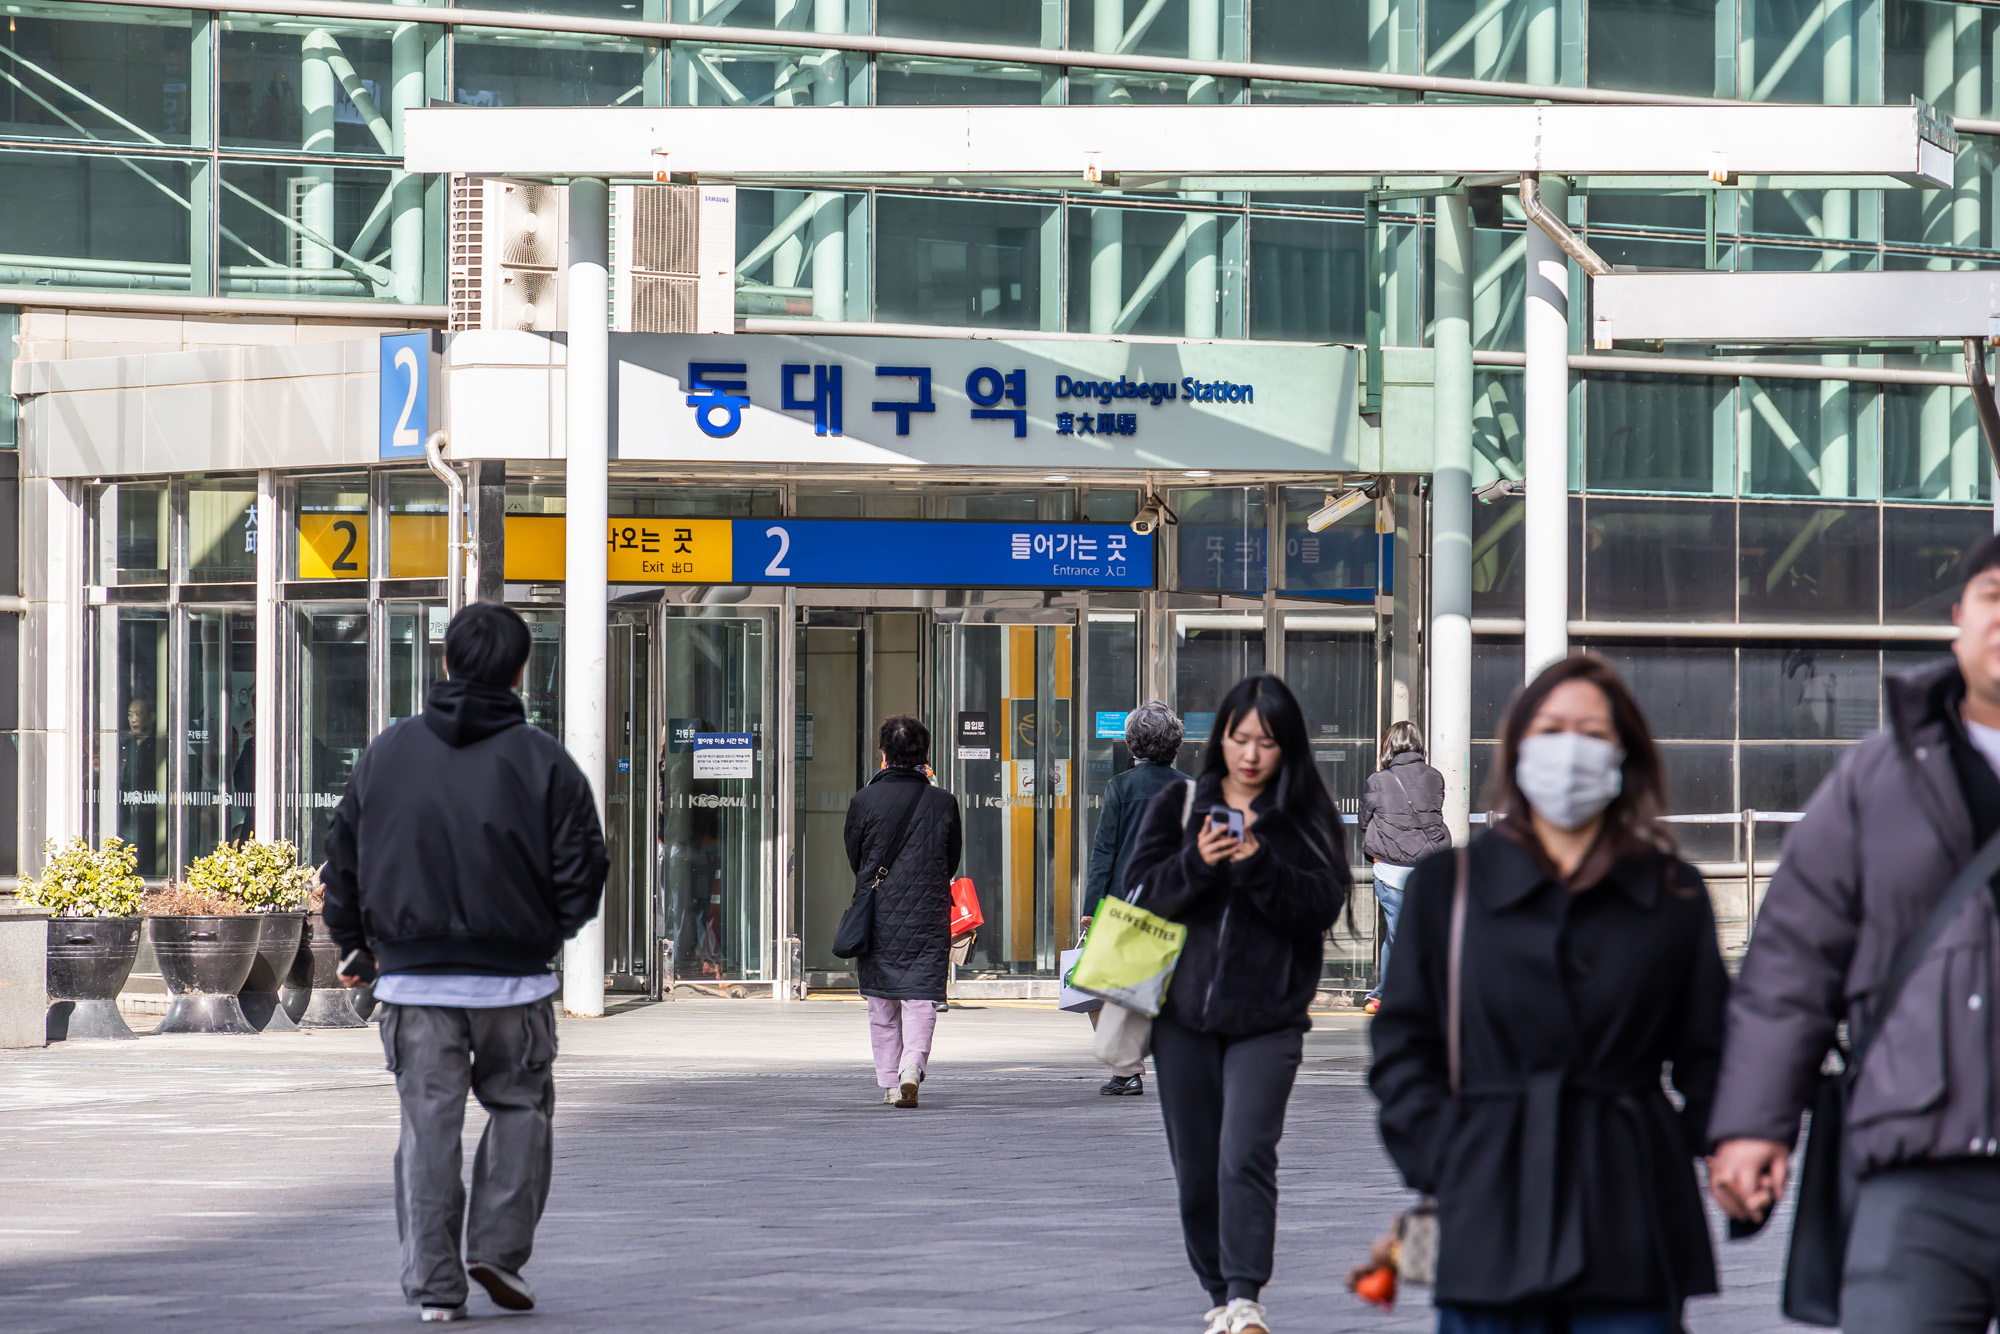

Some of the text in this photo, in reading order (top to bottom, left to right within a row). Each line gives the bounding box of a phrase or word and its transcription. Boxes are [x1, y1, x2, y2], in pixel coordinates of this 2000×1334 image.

[704, 195, 730, 203] SAMSUNG
[393, 346, 419, 447] 2
[1055, 375, 1254, 406] Dongdaegu Station
[686, 362, 1027, 439] 동대구역
[1055, 412, 1137, 436] 東大邱驛
[332, 520, 358, 571] 2
[673, 528, 693, 554] 곳
[1011, 533, 1127, 562] 들어가는 곳
[764, 526, 791, 577] 2
[642, 560, 665, 573] Exit
[671, 561, 693, 574] 出口
[1053, 564, 1100, 576] Entrance
[1104, 565, 1126, 577] 入口
[964, 721, 985, 730] 출입문
[187, 730, 209, 739] 자동문
[726, 737, 737, 745] 시간
[984, 796, 1035, 809] KORAIL
